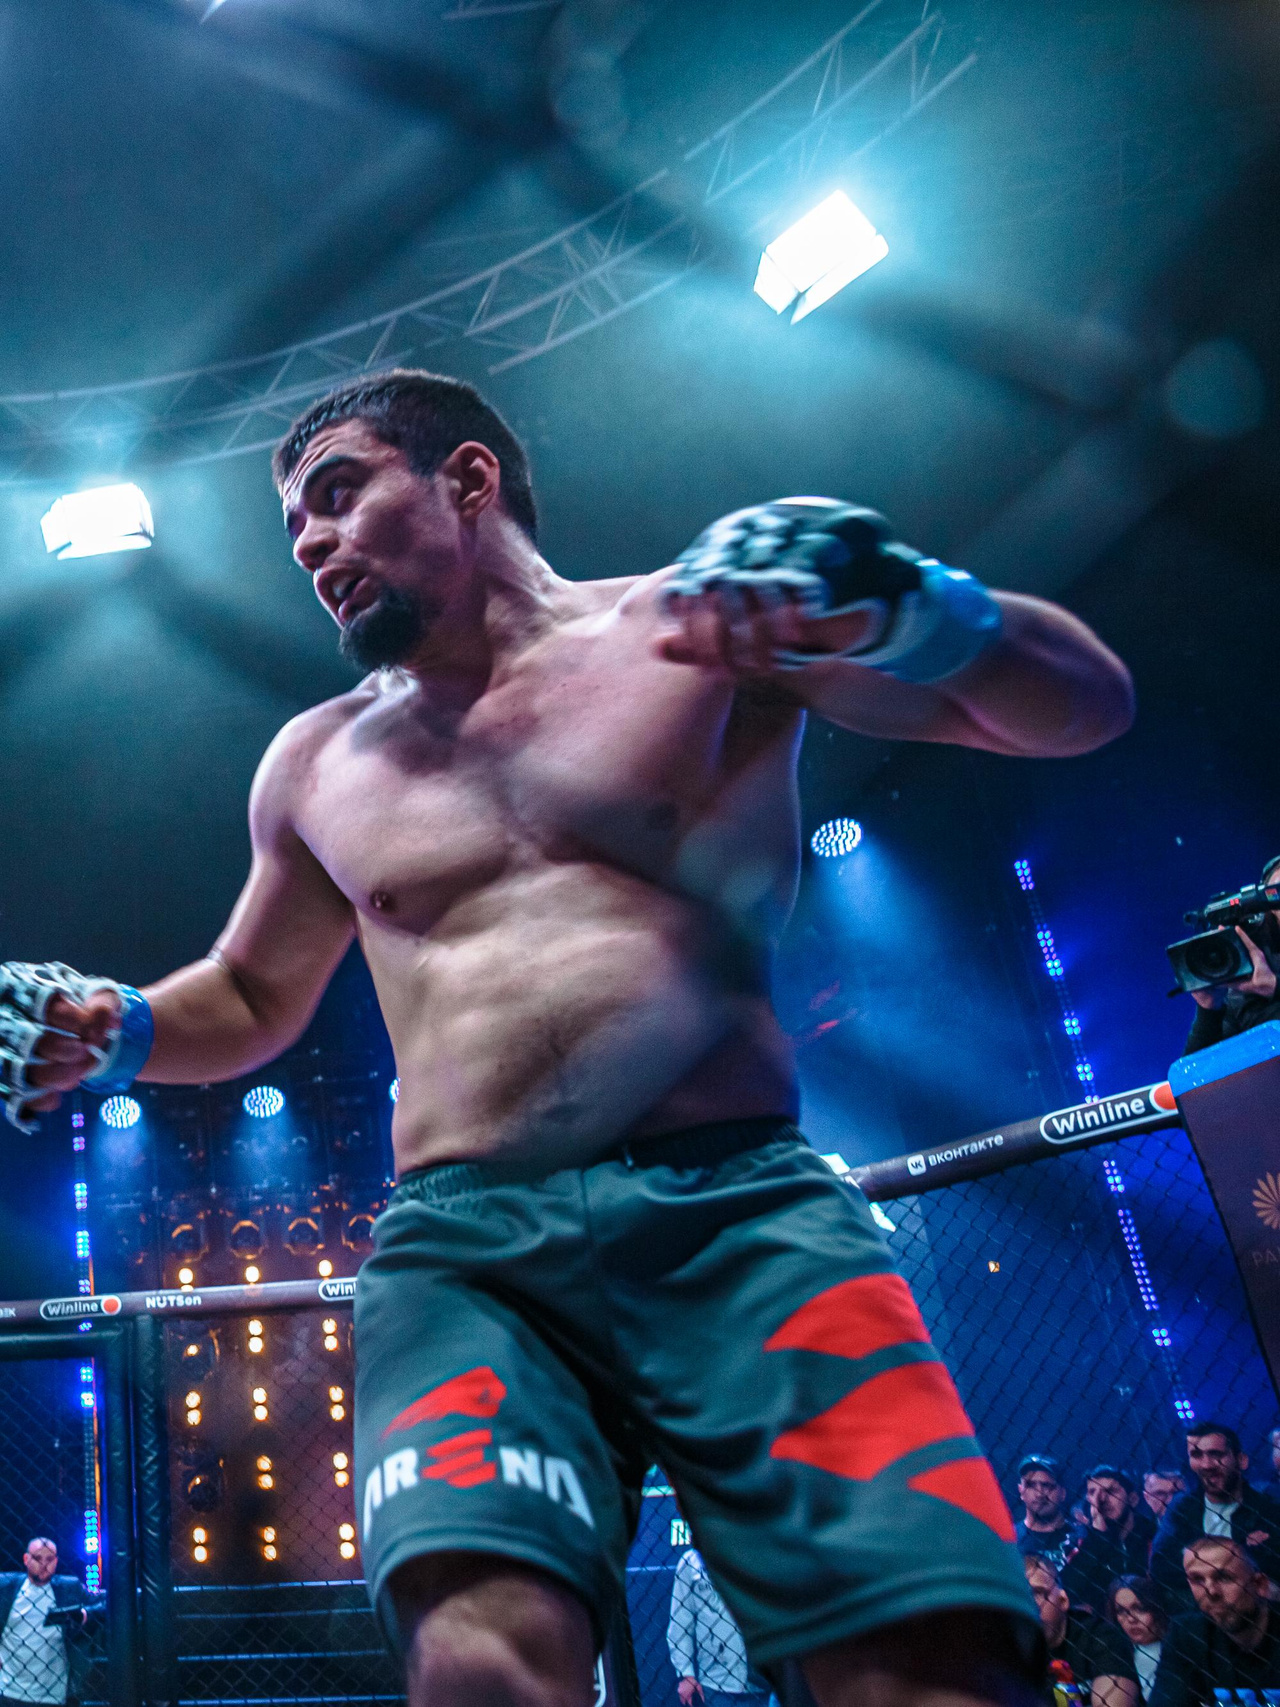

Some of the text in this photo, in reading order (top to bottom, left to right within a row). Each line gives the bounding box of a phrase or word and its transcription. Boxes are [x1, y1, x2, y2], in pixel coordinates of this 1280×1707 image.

[1051, 1097, 1146, 1135] Winline
[325, 1280, 357, 1297] Winl
[47, 1301, 99, 1316] Winline
[146, 1295, 202, 1309] NUTSon
[363, 1428, 596, 1544] ARENA
